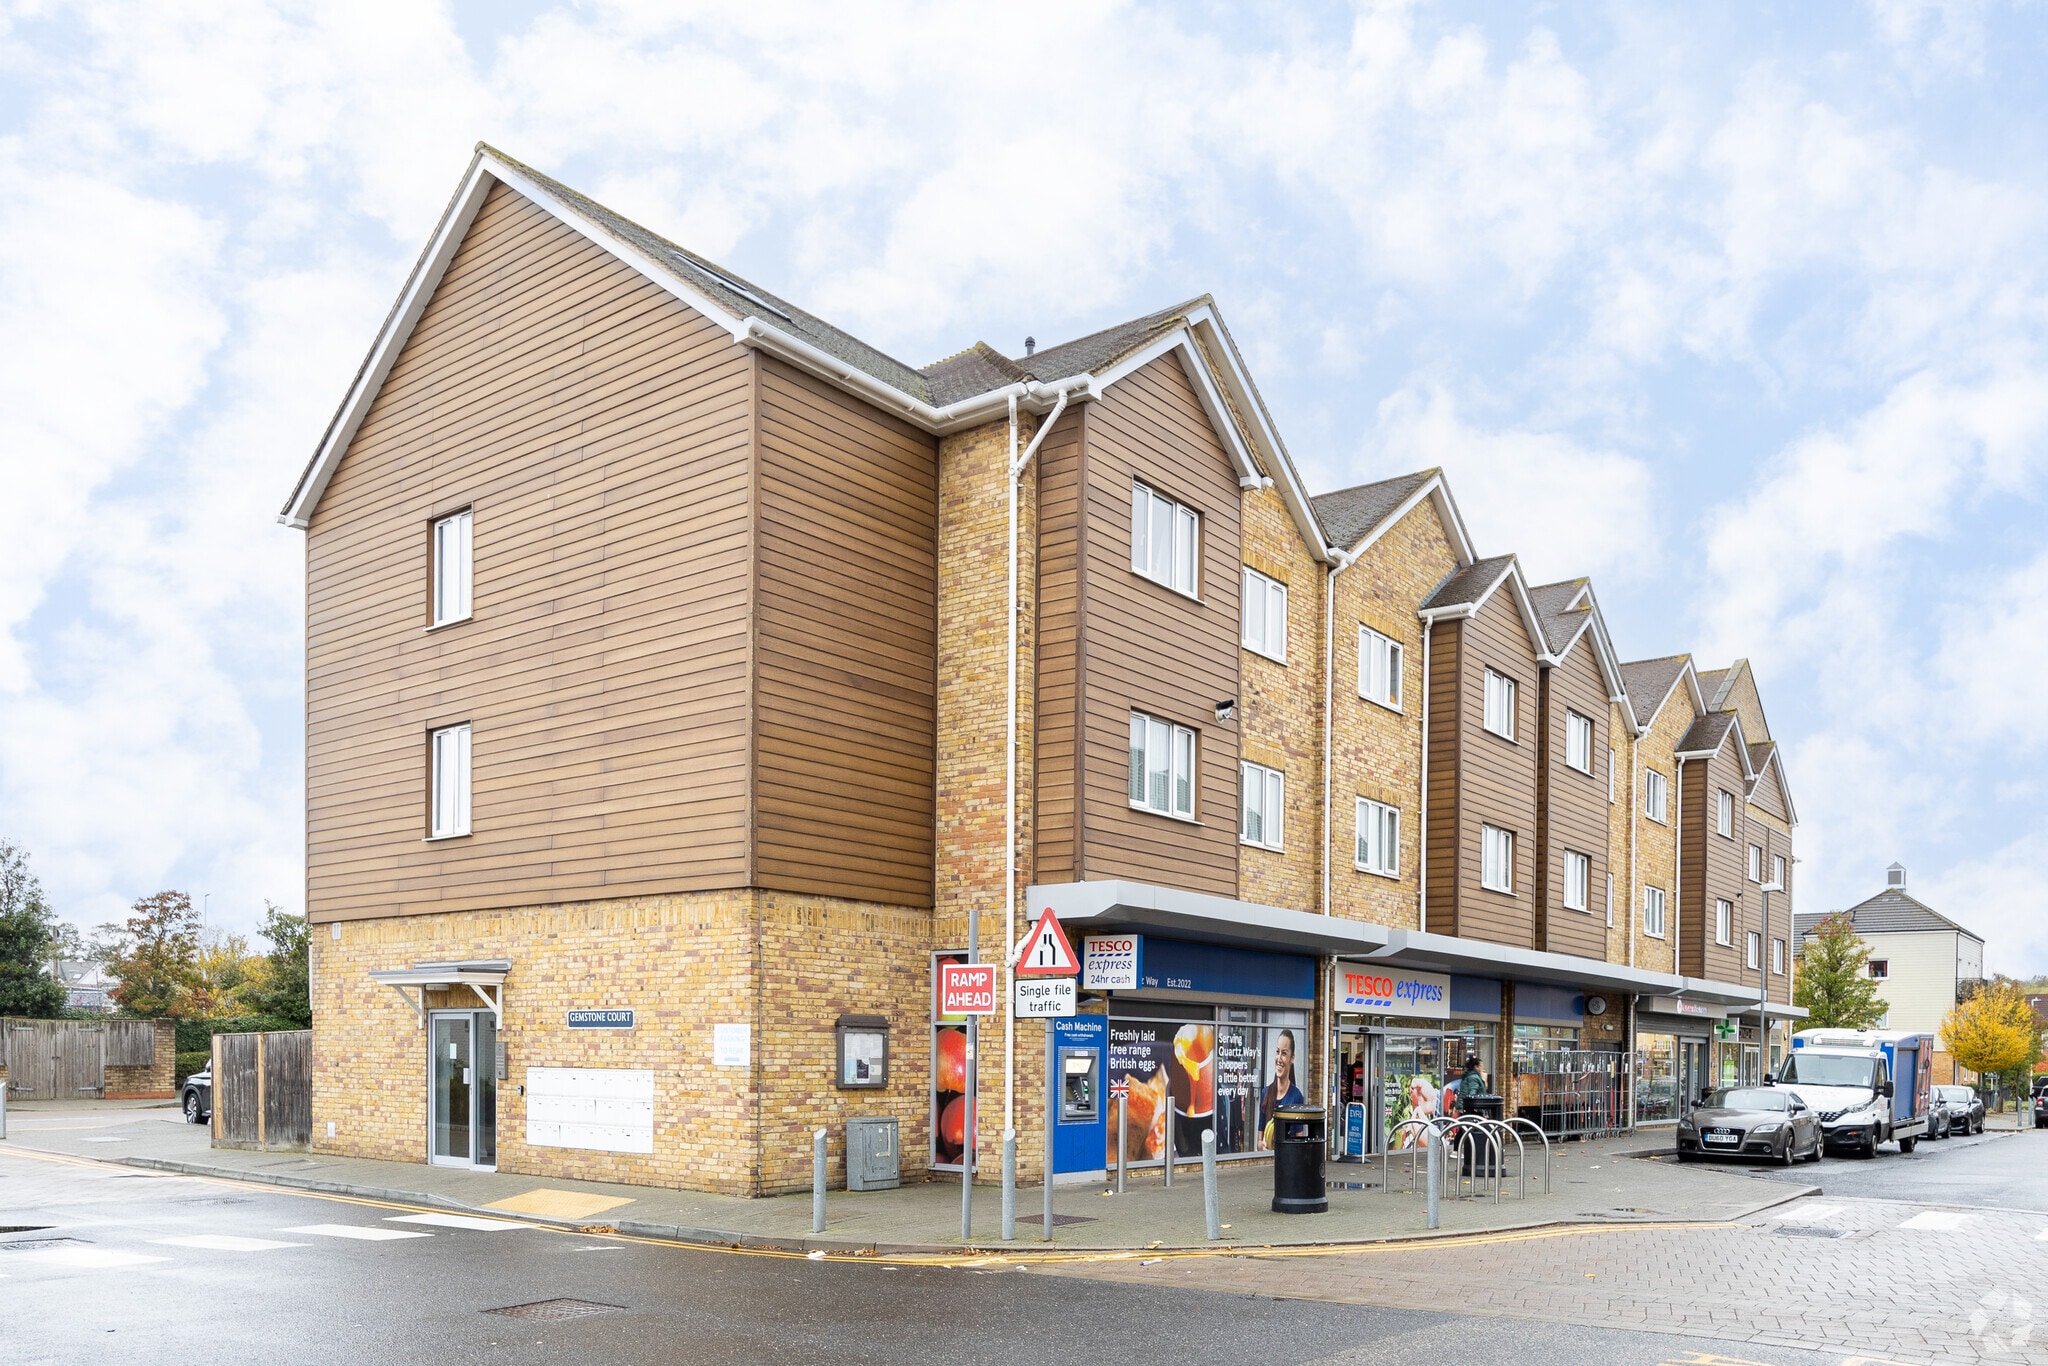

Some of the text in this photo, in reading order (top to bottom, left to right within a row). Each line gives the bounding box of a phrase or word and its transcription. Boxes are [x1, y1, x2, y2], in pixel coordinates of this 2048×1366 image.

[1089, 940, 1133, 952] TESCO
[1088, 959, 1132, 973] express
[950, 972, 988, 987] RAMP
[1091, 975, 1109, 984] 24hr
[1111, 974, 1131, 984] cash
[1146, 976, 1159, 987] Way
[1020, 984, 1071, 998] Single file
[1345, 973, 1443, 1007] TESCO express
[947, 992, 992, 1006] AHEAD
[1029, 1001, 1062, 1012] traffic
[569, 1012, 631, 1022] GEMSTONE COURT
[1056, 1021, 1102, 1032] Cash Machine
[1110, 1028, 1155, 1043] Freshly laid
[1218, 1033, 1242, 1046] Serving
[1110, 1043, 1151, 1057] free range
[1218, 1046, 1261, 1059] Quartz Way's
[1110, 1058, 1137, 1070] British
[1218, 1059, 1248, 1072] shoppers
[1218, 1072, 1258, 1083] a little better
[1218, 1087, 1249, 1098] every day
